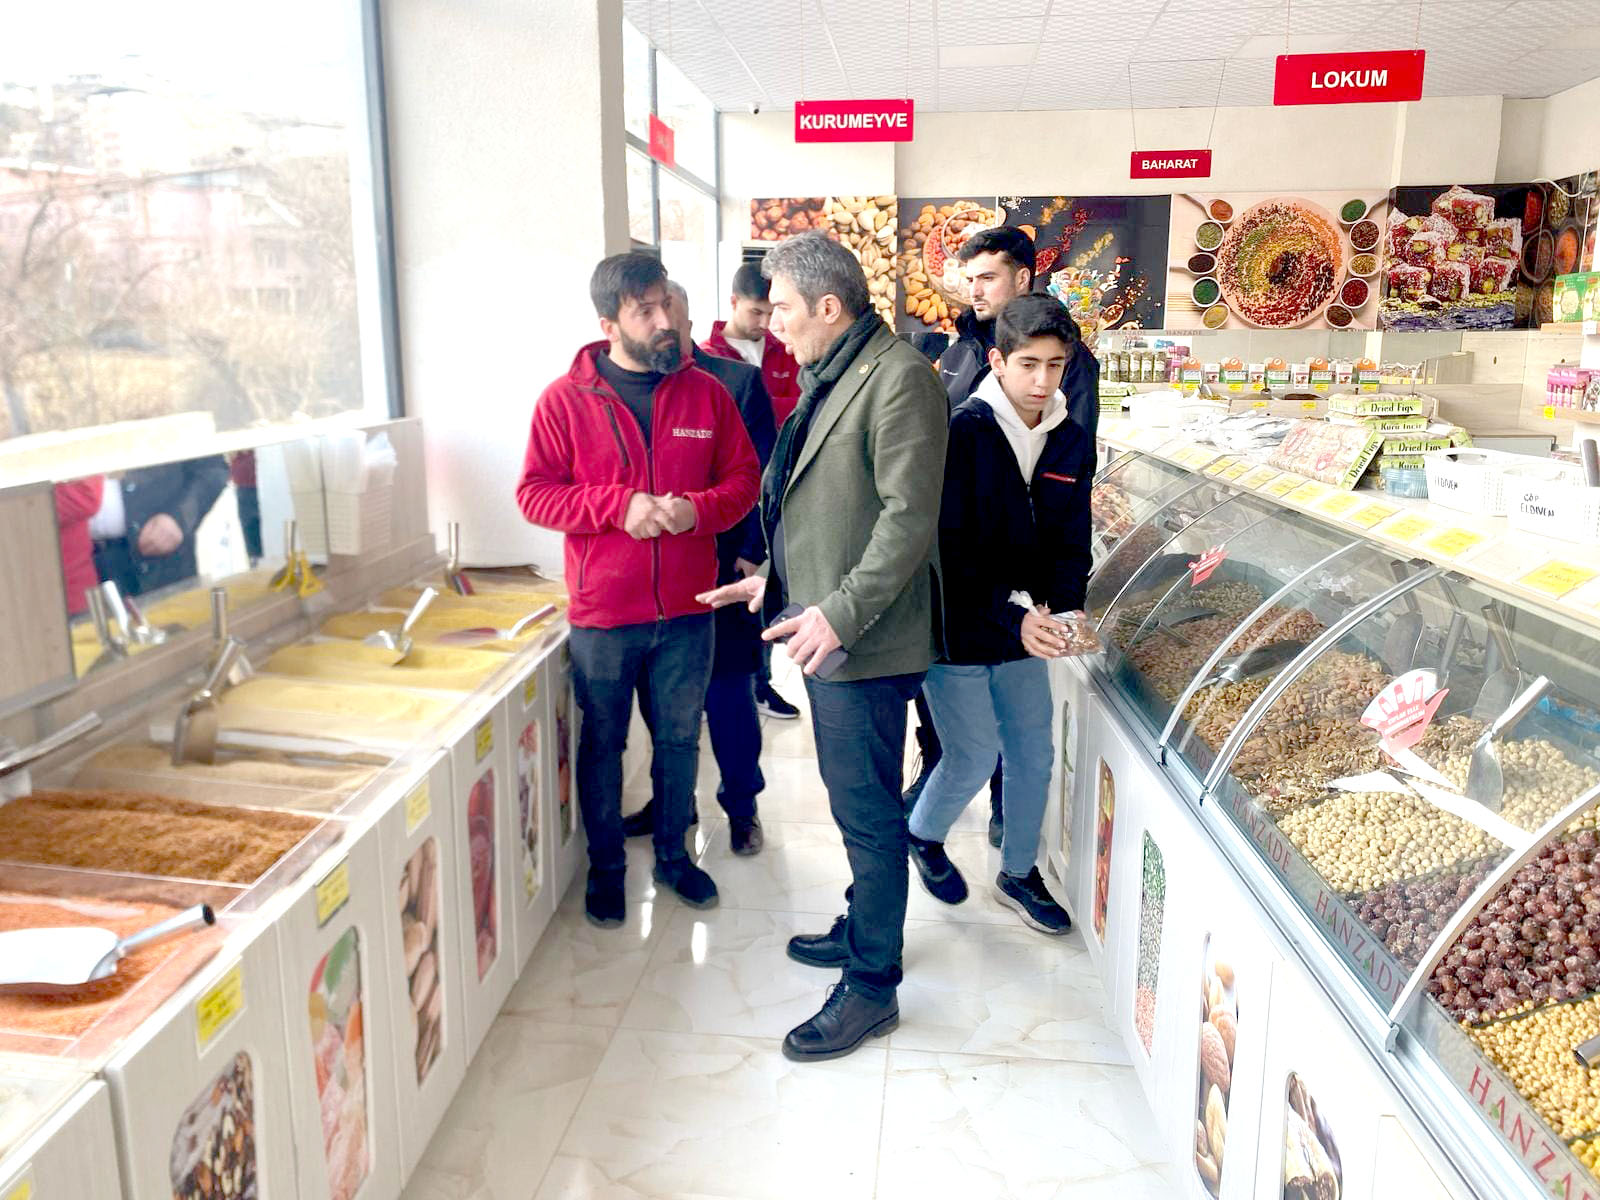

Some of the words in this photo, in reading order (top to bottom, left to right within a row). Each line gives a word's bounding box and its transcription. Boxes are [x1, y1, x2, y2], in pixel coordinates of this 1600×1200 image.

[1311, 69, 1388, 89] LOKUM
[799, 112, 908, 130] KURUMEYVE
[1141, 158, 1199, 170] BAHARAT
[1370, 402, 1394, 412] Dried
[1397, 402, 1414, 413] Figs
[1398, 442, 1422, 452] Dried
[1348, 453, 1367, 479] Dried
[1232, 791, 1291, 874] HANZADE
[1468, 1063, 1596, 1200] HANZA
